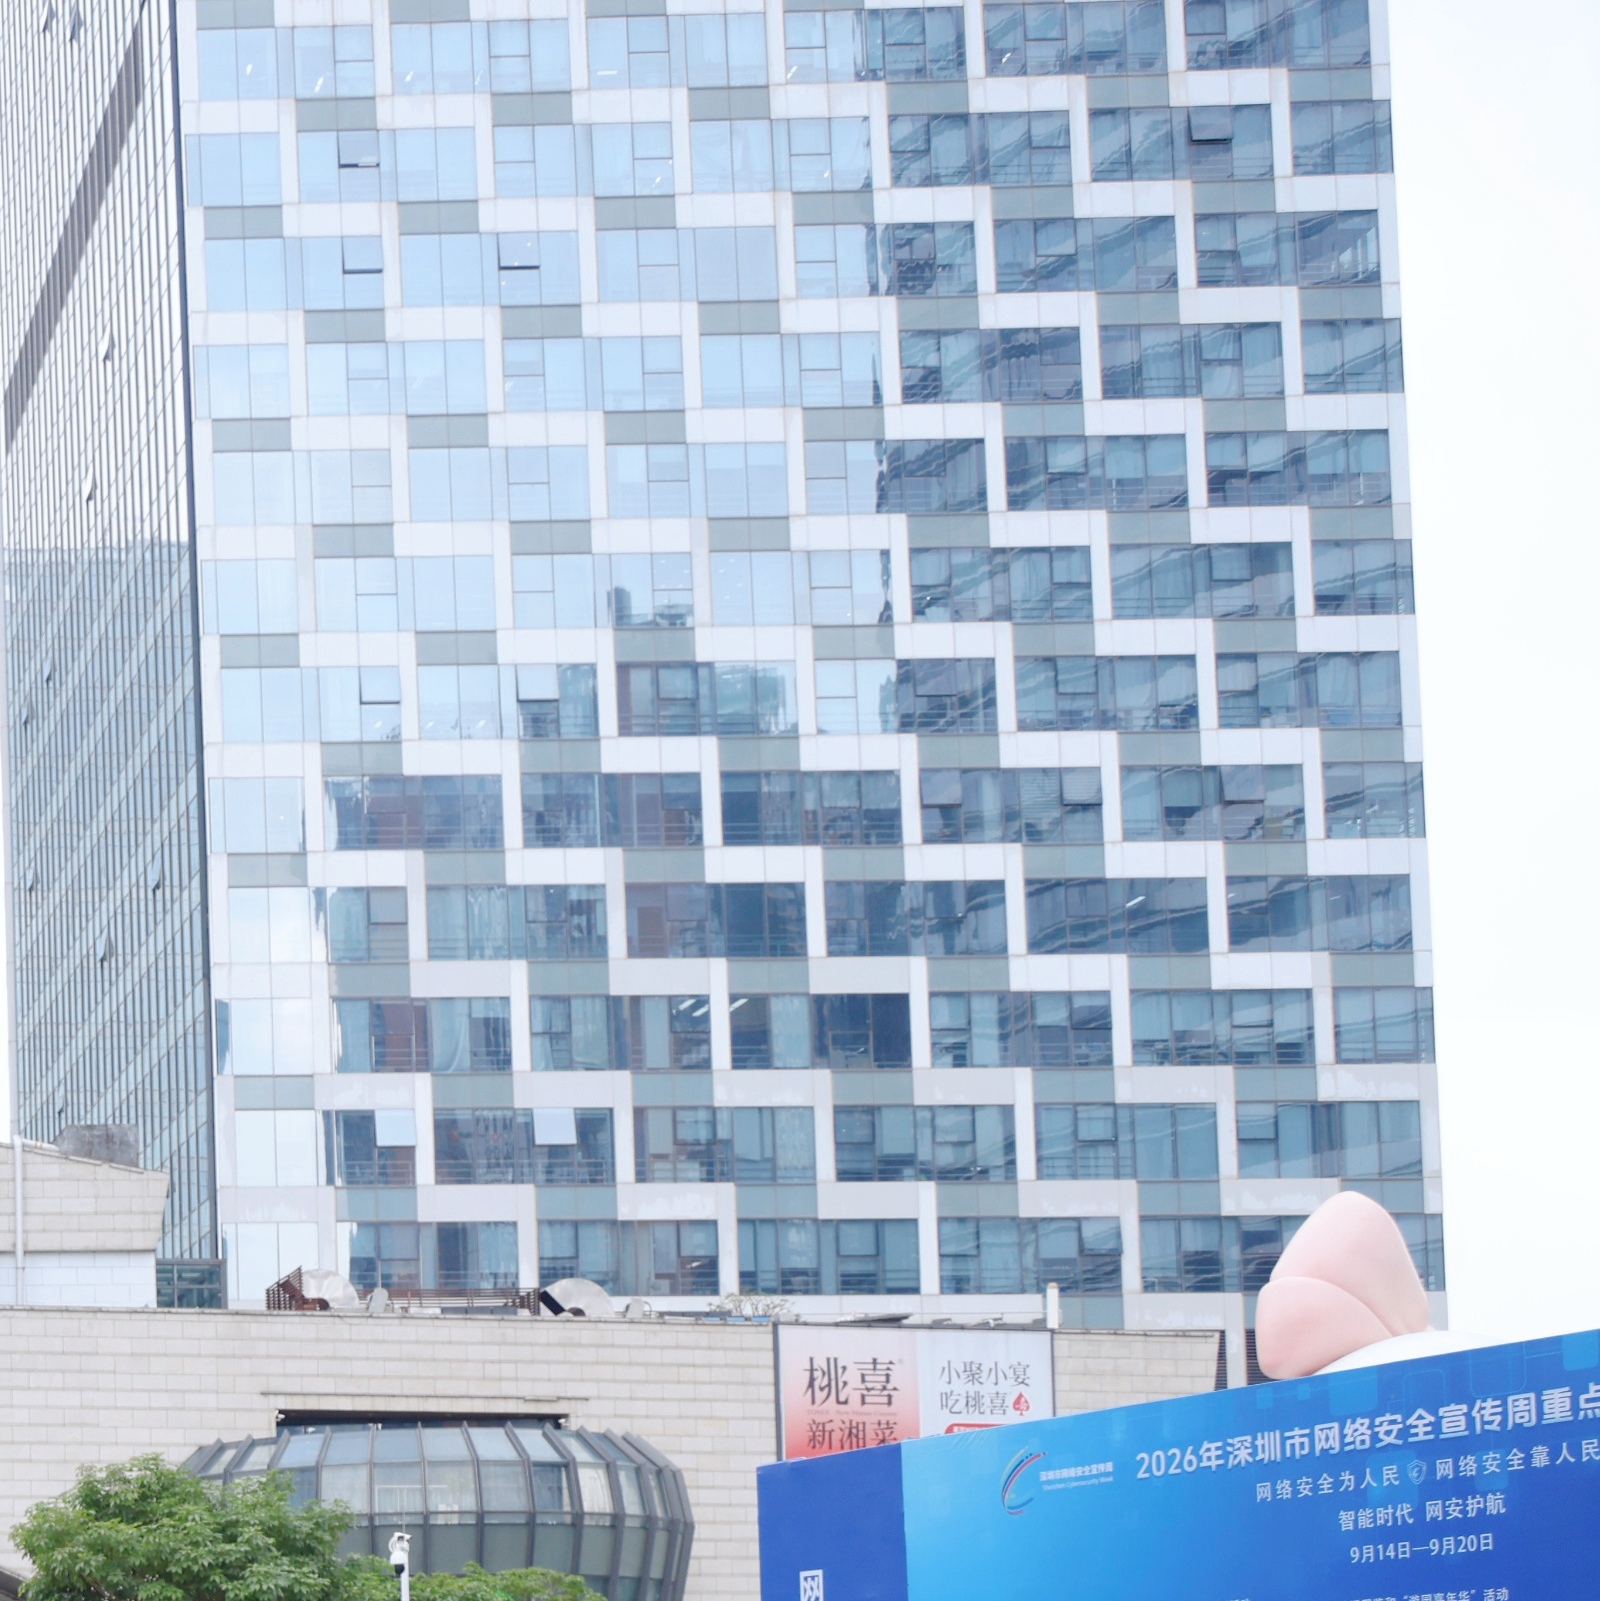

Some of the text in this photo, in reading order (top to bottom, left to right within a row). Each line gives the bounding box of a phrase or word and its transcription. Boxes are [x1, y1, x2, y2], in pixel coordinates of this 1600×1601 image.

[803, 1355, 899, 1408] 桃喜
[939, 1360, 1031, 1387] 小聚小宴
[940, 1391, 1010, 1416] 吃桃喜
[806, 1419, 898, 1450] 新湘菜
[1256, 1438, 1600, 1502] 网络安全为人民 网络安全靠人民
[1338, 1494, 1507, 1532] 智能时代 网安护航
